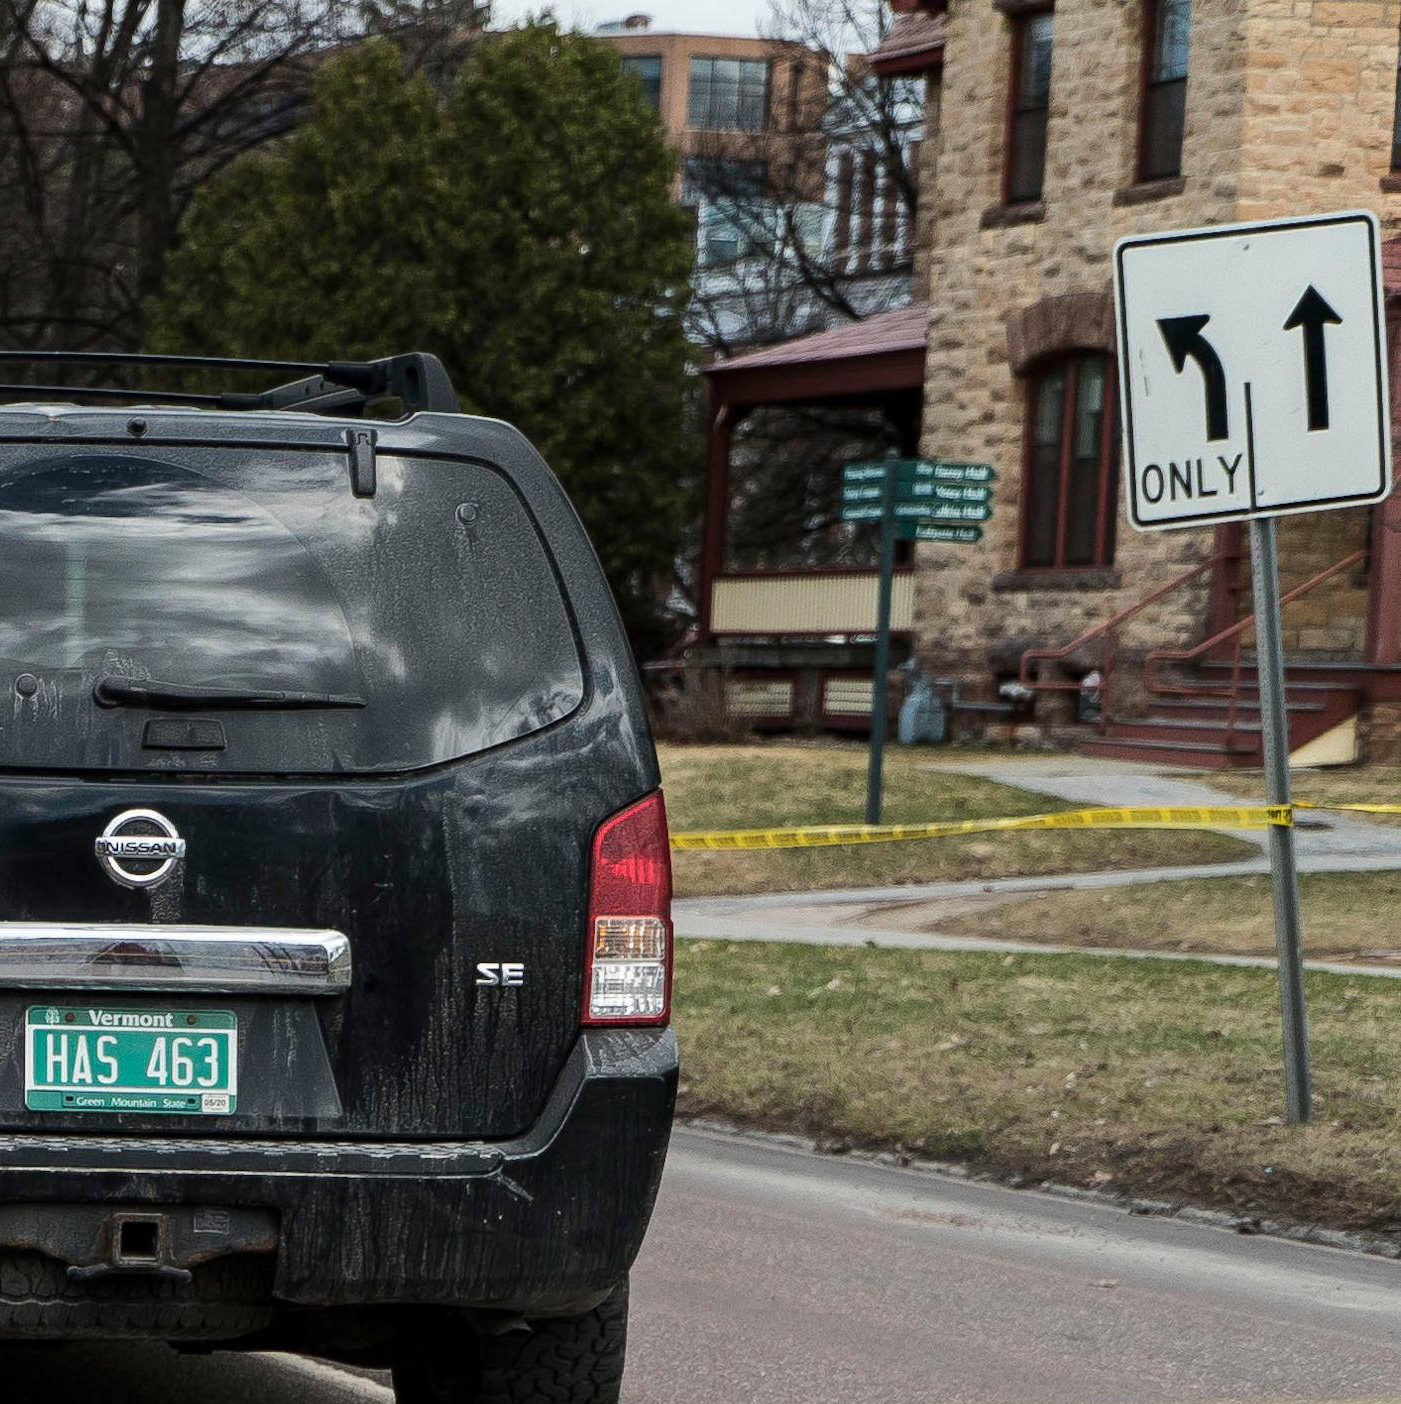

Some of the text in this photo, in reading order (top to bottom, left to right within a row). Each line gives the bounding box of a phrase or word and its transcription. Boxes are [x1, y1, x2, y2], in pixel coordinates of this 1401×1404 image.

[1142, 453, 1243, 505] ONLY
[106, 842, 177, 855] NISSAN
[476, 963, 524, 986] SE
[88, 1009, 174, 1028] Vermont
[46, 1034, 219, 1087] HAS 463
[76, 1097, 186, 1109] Green Mountain State
